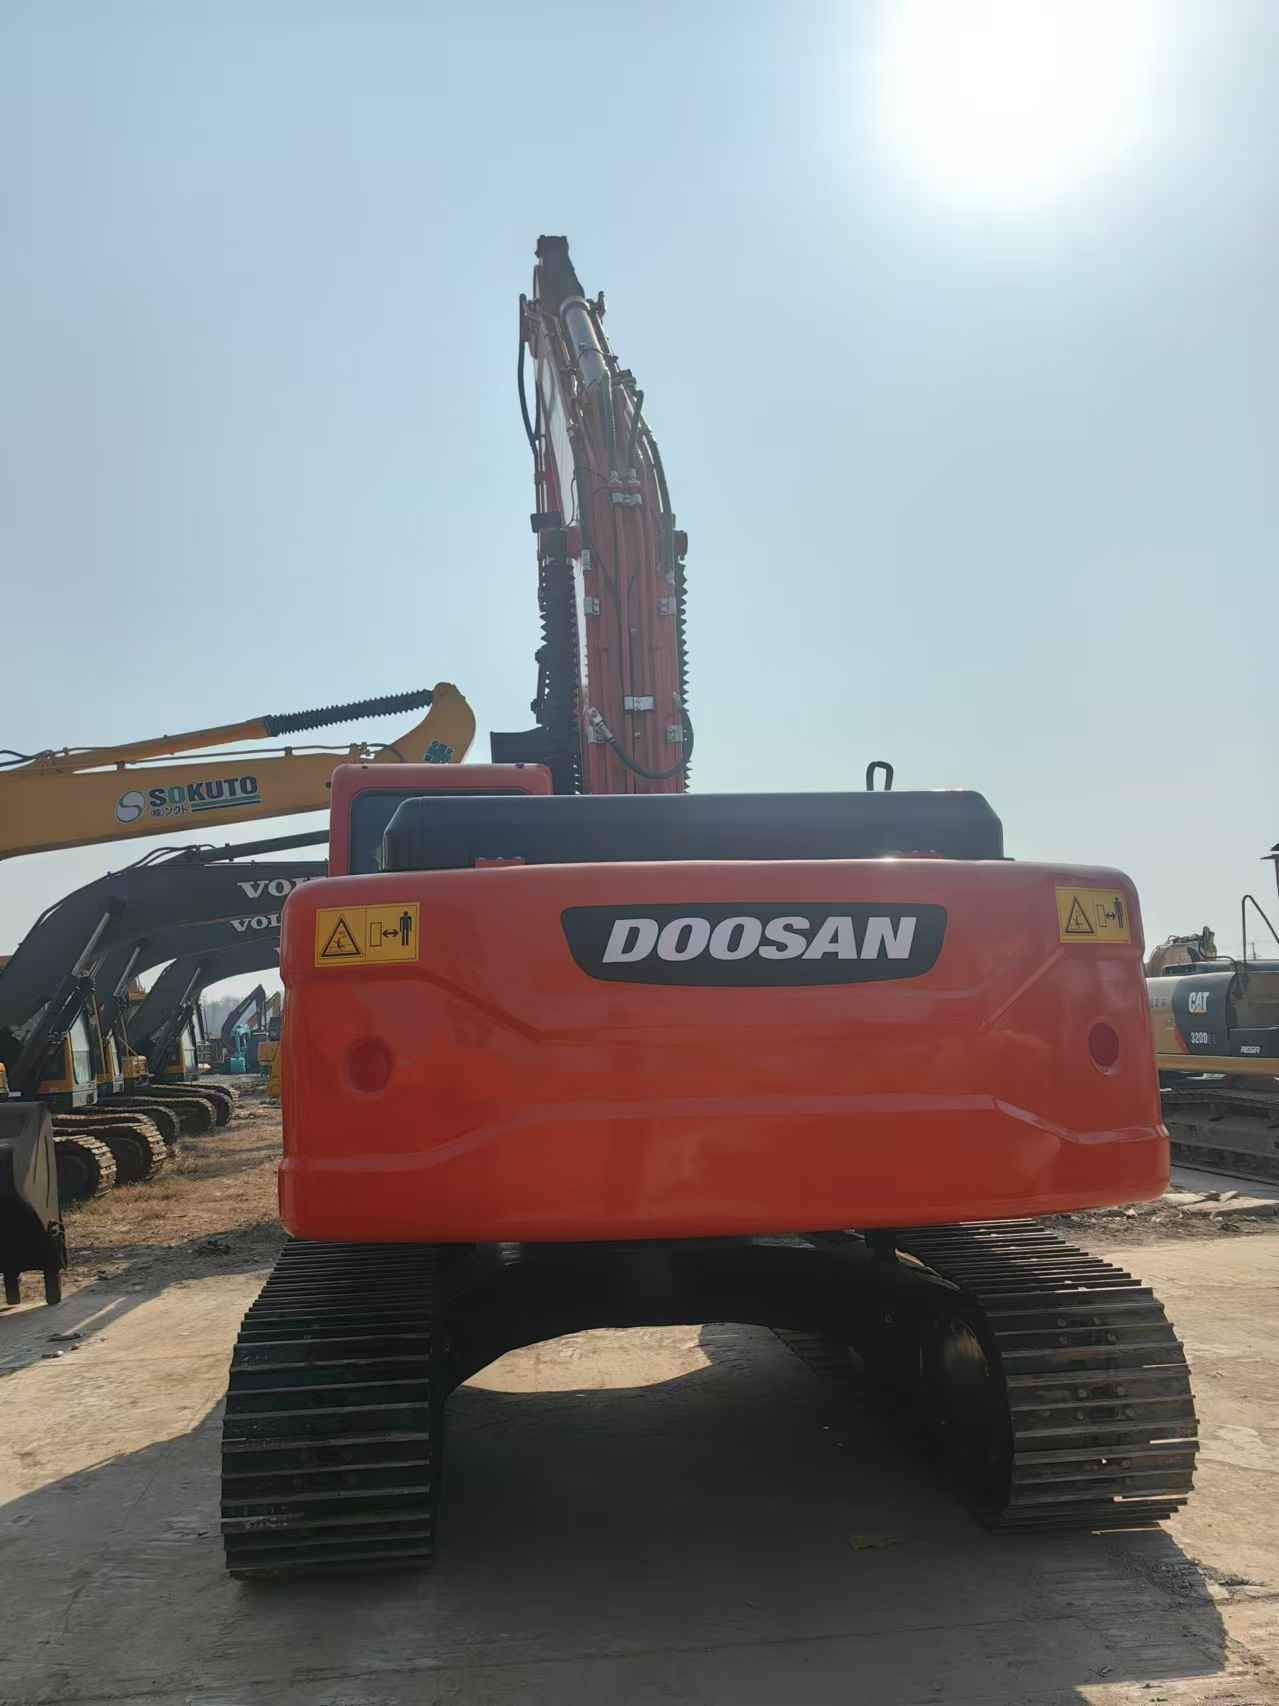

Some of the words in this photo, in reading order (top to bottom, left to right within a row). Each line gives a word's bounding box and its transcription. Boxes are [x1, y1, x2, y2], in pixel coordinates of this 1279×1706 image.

[149, 776, 258, 807] SOKUTO
[602, 916, 917, 963] DOOSAN
[1189, 992, 1210, 1013] CAT
